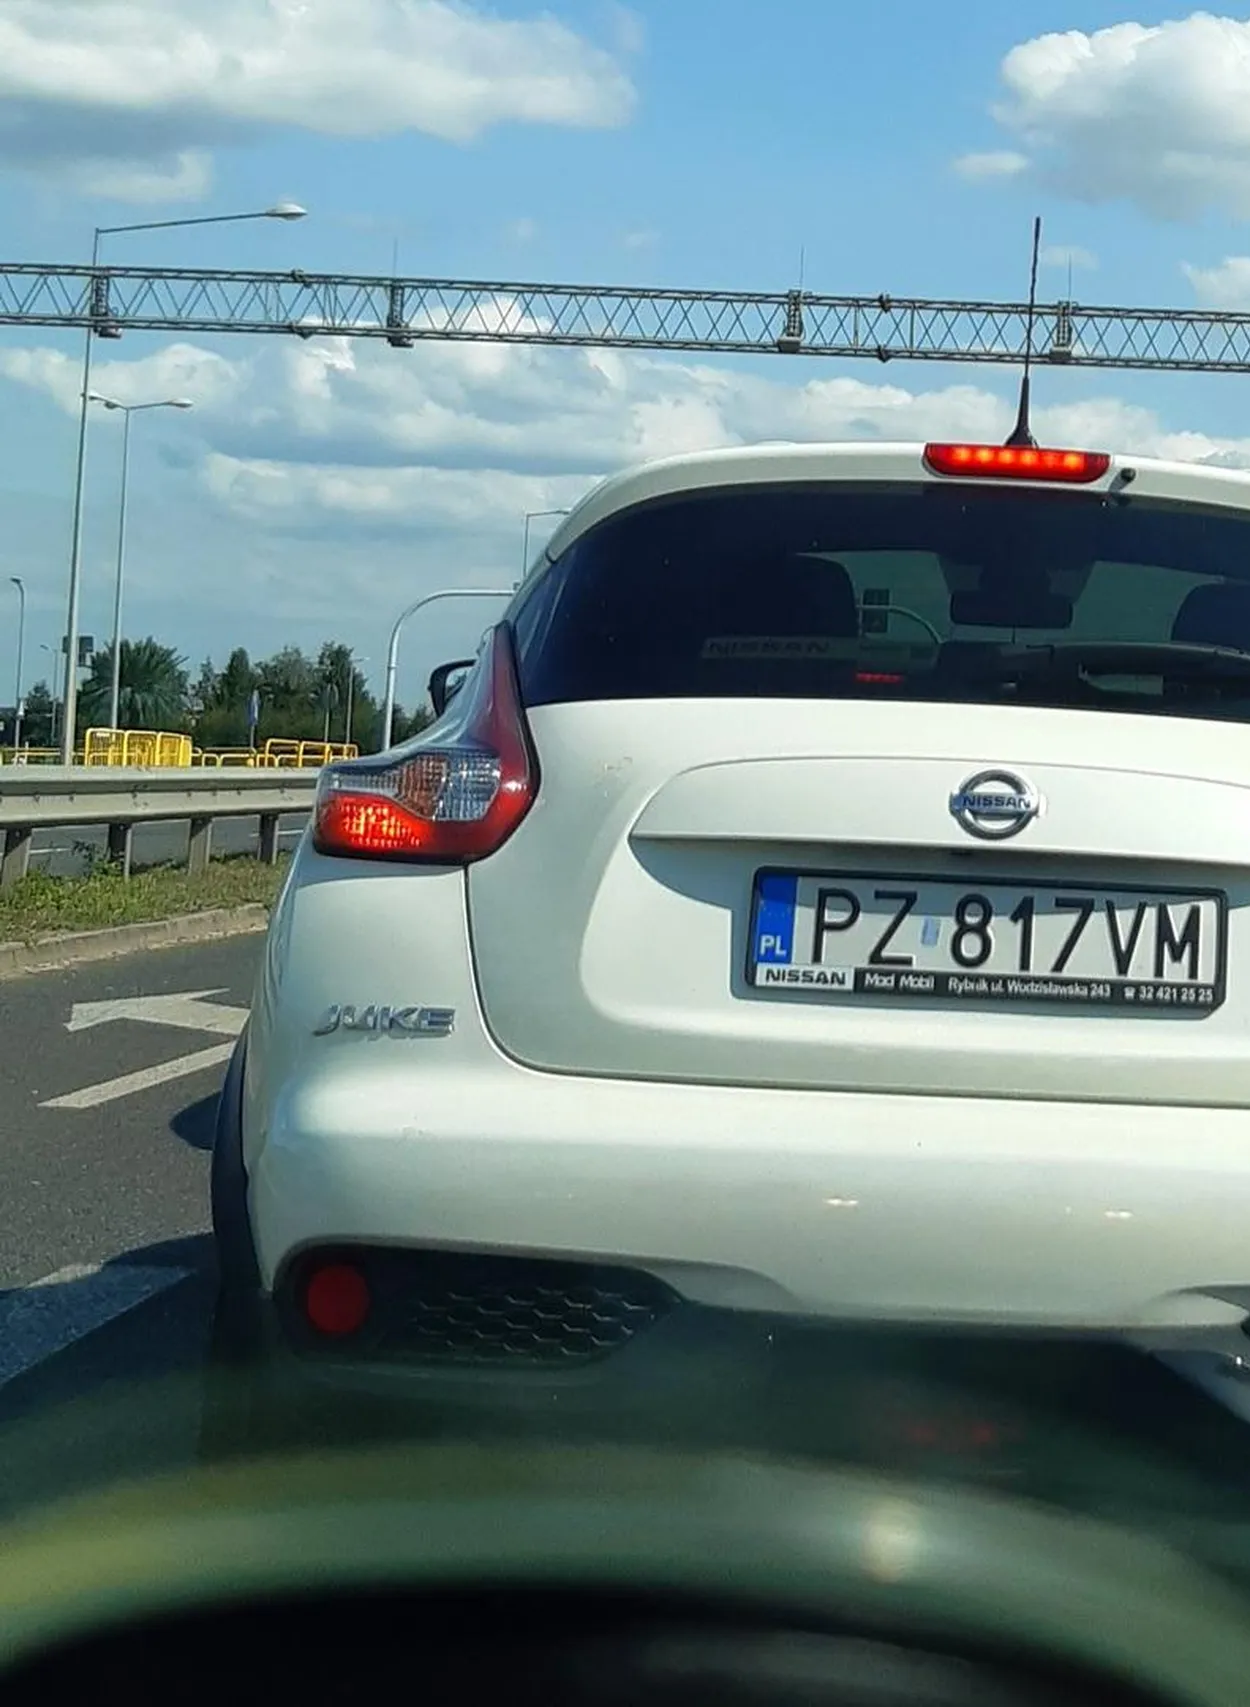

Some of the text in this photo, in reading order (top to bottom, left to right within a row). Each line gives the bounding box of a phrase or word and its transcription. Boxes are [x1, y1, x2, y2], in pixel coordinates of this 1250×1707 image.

[963, 794, 1031, 808] NISSAN
[760, 934, 786, 957] PL
[811, 888, 1201, 980] PZ 817VM
[765, 969, 846, 986] NISSAN
[899, 975, 935, 990] Mobil
[948, 977, 989, 994] Rybnik
[1090, 983, 1111, 997] 243
[1139, 985, 1154, 1001] 32
[1156, 986, 1177, 1003] 421
[1181, 987, 1195, 1003] 25
[1198, 988, 1213, 1003] 25
